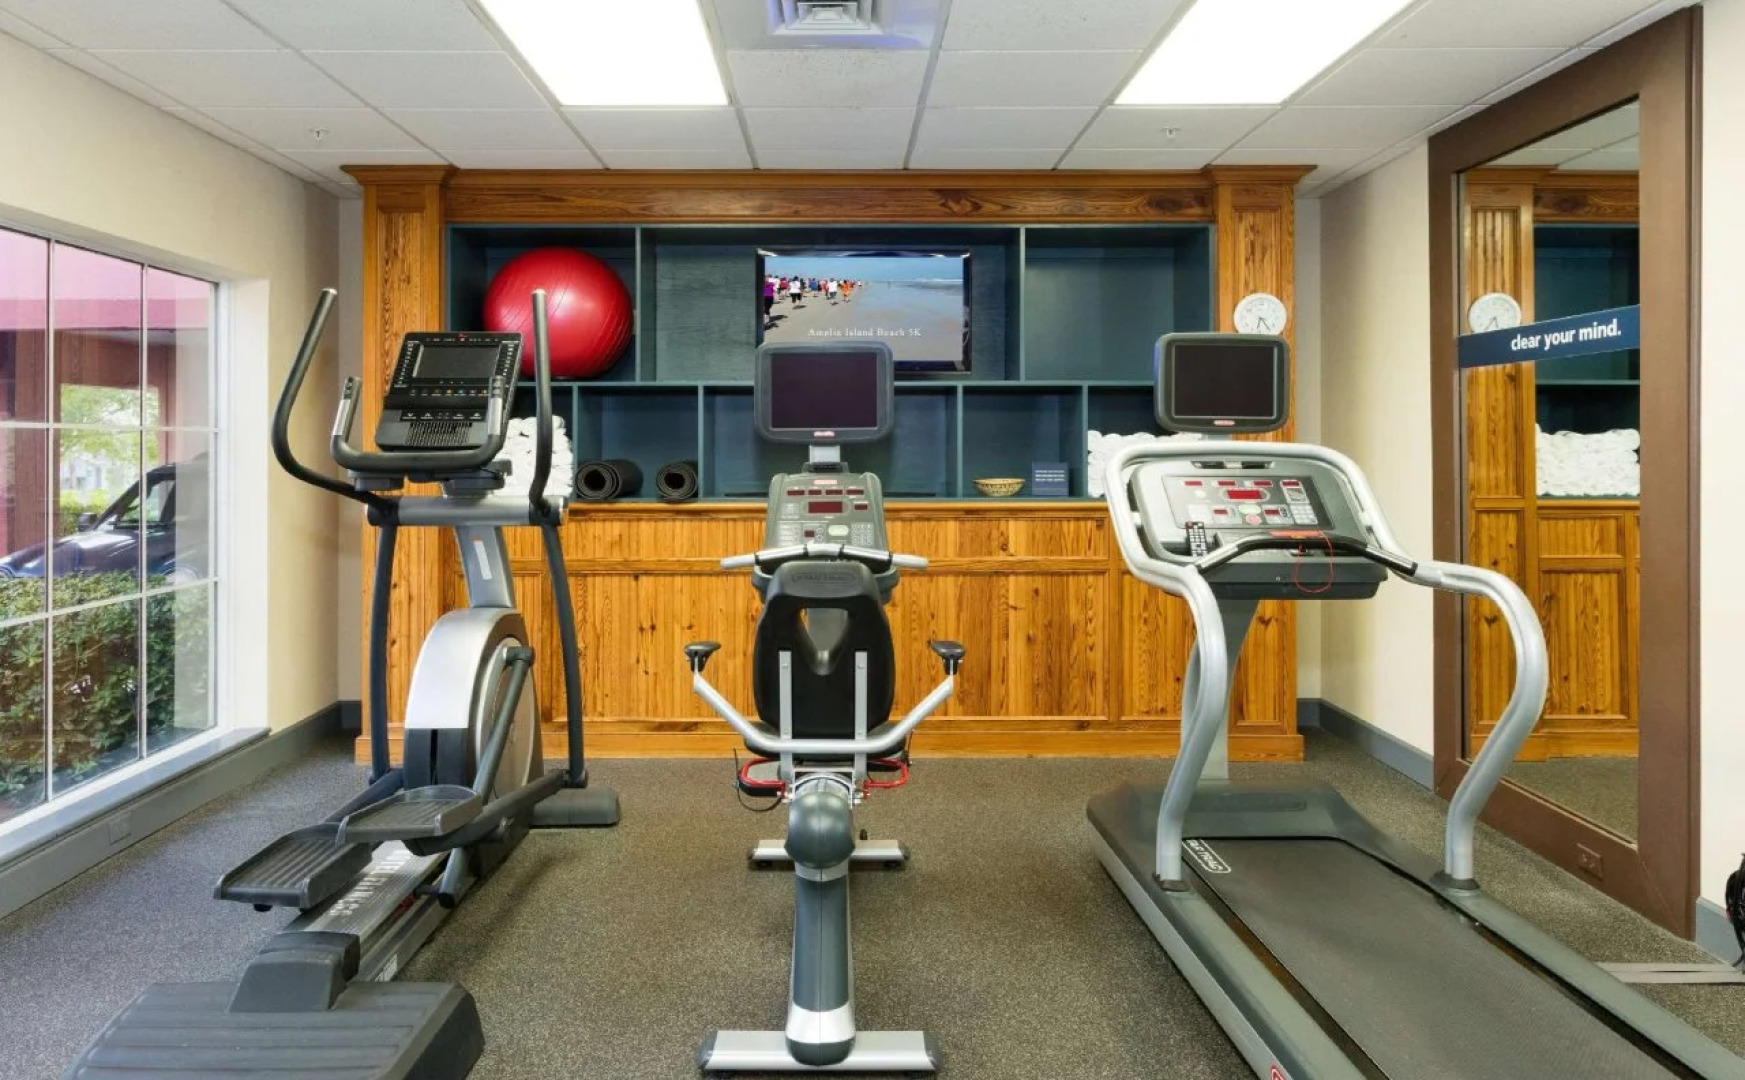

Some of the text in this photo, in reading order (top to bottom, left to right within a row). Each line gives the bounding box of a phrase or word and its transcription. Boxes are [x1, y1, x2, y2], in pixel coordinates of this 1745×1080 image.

[808, 327, 922, 337] Amelia Island Beach 5K
[1511, 318, 1622, 352] clear your mind.
